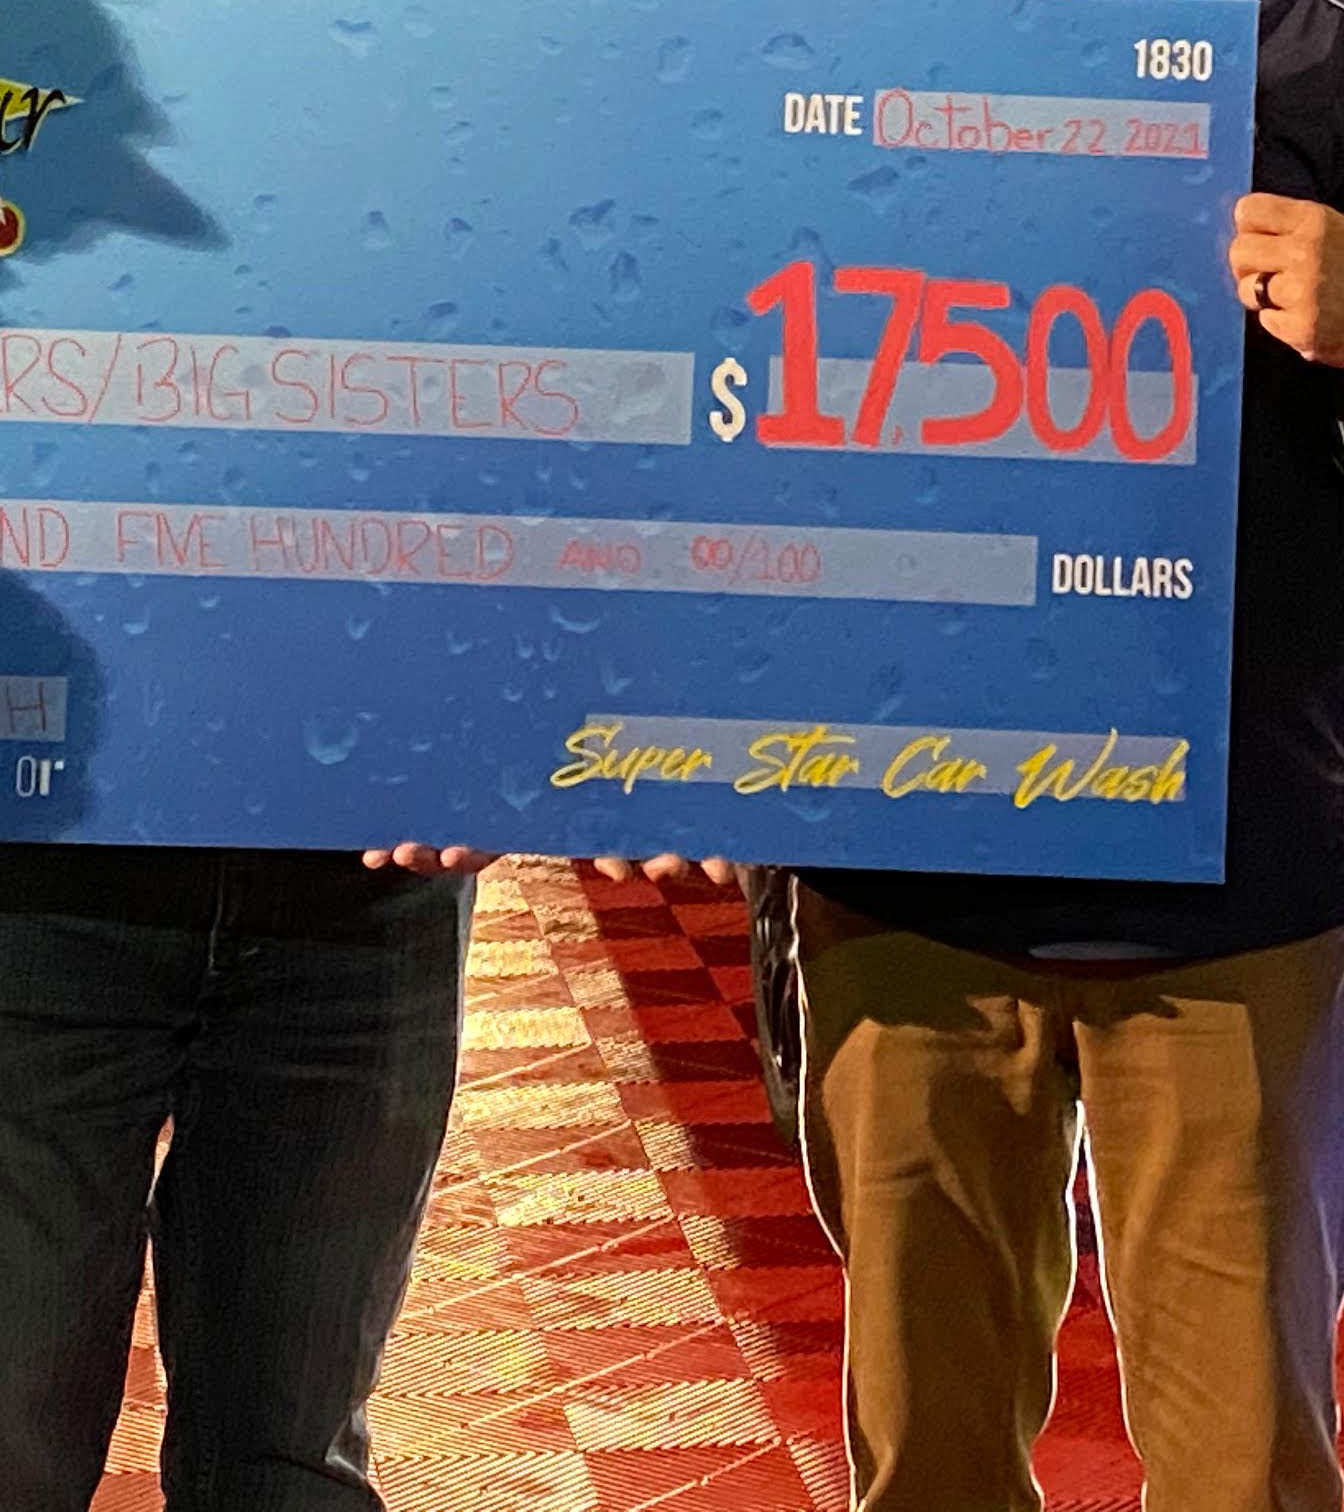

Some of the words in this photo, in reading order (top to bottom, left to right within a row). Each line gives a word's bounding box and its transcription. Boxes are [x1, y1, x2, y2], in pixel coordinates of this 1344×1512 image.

[1133, 39, 1213, 81] 1830
[784, 92, 863, 136] DATE
[877, 88, 1053, 152] October
[1062, 118, 1107, 154] 22
[271, 348, 581, 437] SISTERS
[116, 509, 226, 570] FIVE
[249, 514, 515, 579] HUNDRED
[559, 536, 642, 573] AND
[1052, 554, 1193, 600] DOLLARS
[550, 721, 712, 796] Super
[733, 725, 860, 794] Star
[882, 734, 987, 798] Car
[1014, 726, 1190, 810] Wash
